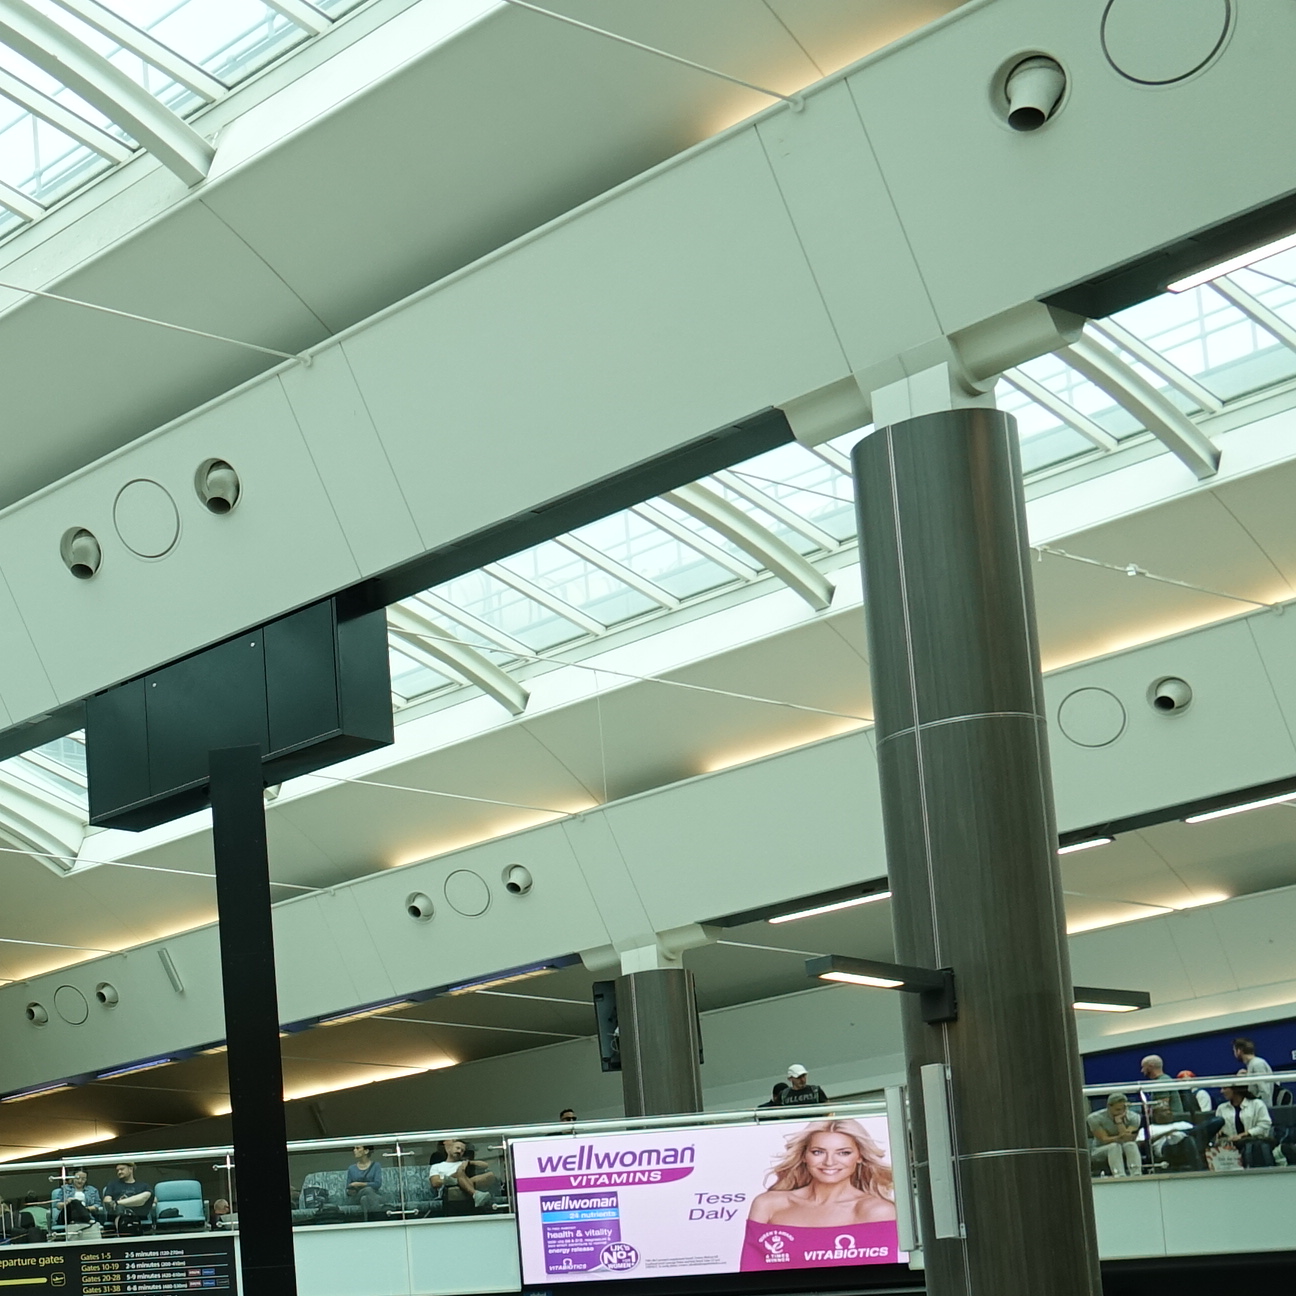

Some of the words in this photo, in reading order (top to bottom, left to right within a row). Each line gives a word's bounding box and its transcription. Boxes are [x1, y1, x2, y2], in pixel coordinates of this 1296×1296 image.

[537, 1144, 696, 1173] wellwoman
[569, 1171, 662, 1187] VITAMINS
[541, 1196, 617, 1211] wellwoman
[694, 1192, 746, 1205] Tess
[580, 1211, 617, 1219] nutrients
[688, 1207, 738, 1221] Daly
[547, 1230, 574, 1239] health
[584, 1228, 613, 1238] vitality
[80, 1253, 99, 1261] Gates
[101, 1252, 112, 1260] 1-5
[125, 1251, 135, 1259] 2-5
[135, 1250, 159, 1258] minutes
[804, 1247, 888, 1261] VITABIOTICS
[38, 1255, 65, 1267] gates
[81, 1264, 100, 1272] Gates
[125, 1262, 135, 1270] 2-6
[136, 1261, 159, 1269] minutes
[82, 1275, 101, 1283] Gates
[103, 1274, 121, 1282] 20-28
[126, 1273, 137, 1281] 5-9
[137, 1272, 161, 1280] minutes
[82, 1286, 101, 1294] Gates
[103, 1285, 121, 1293] 31-38
[138, 1283, 162, 1291] minutes
